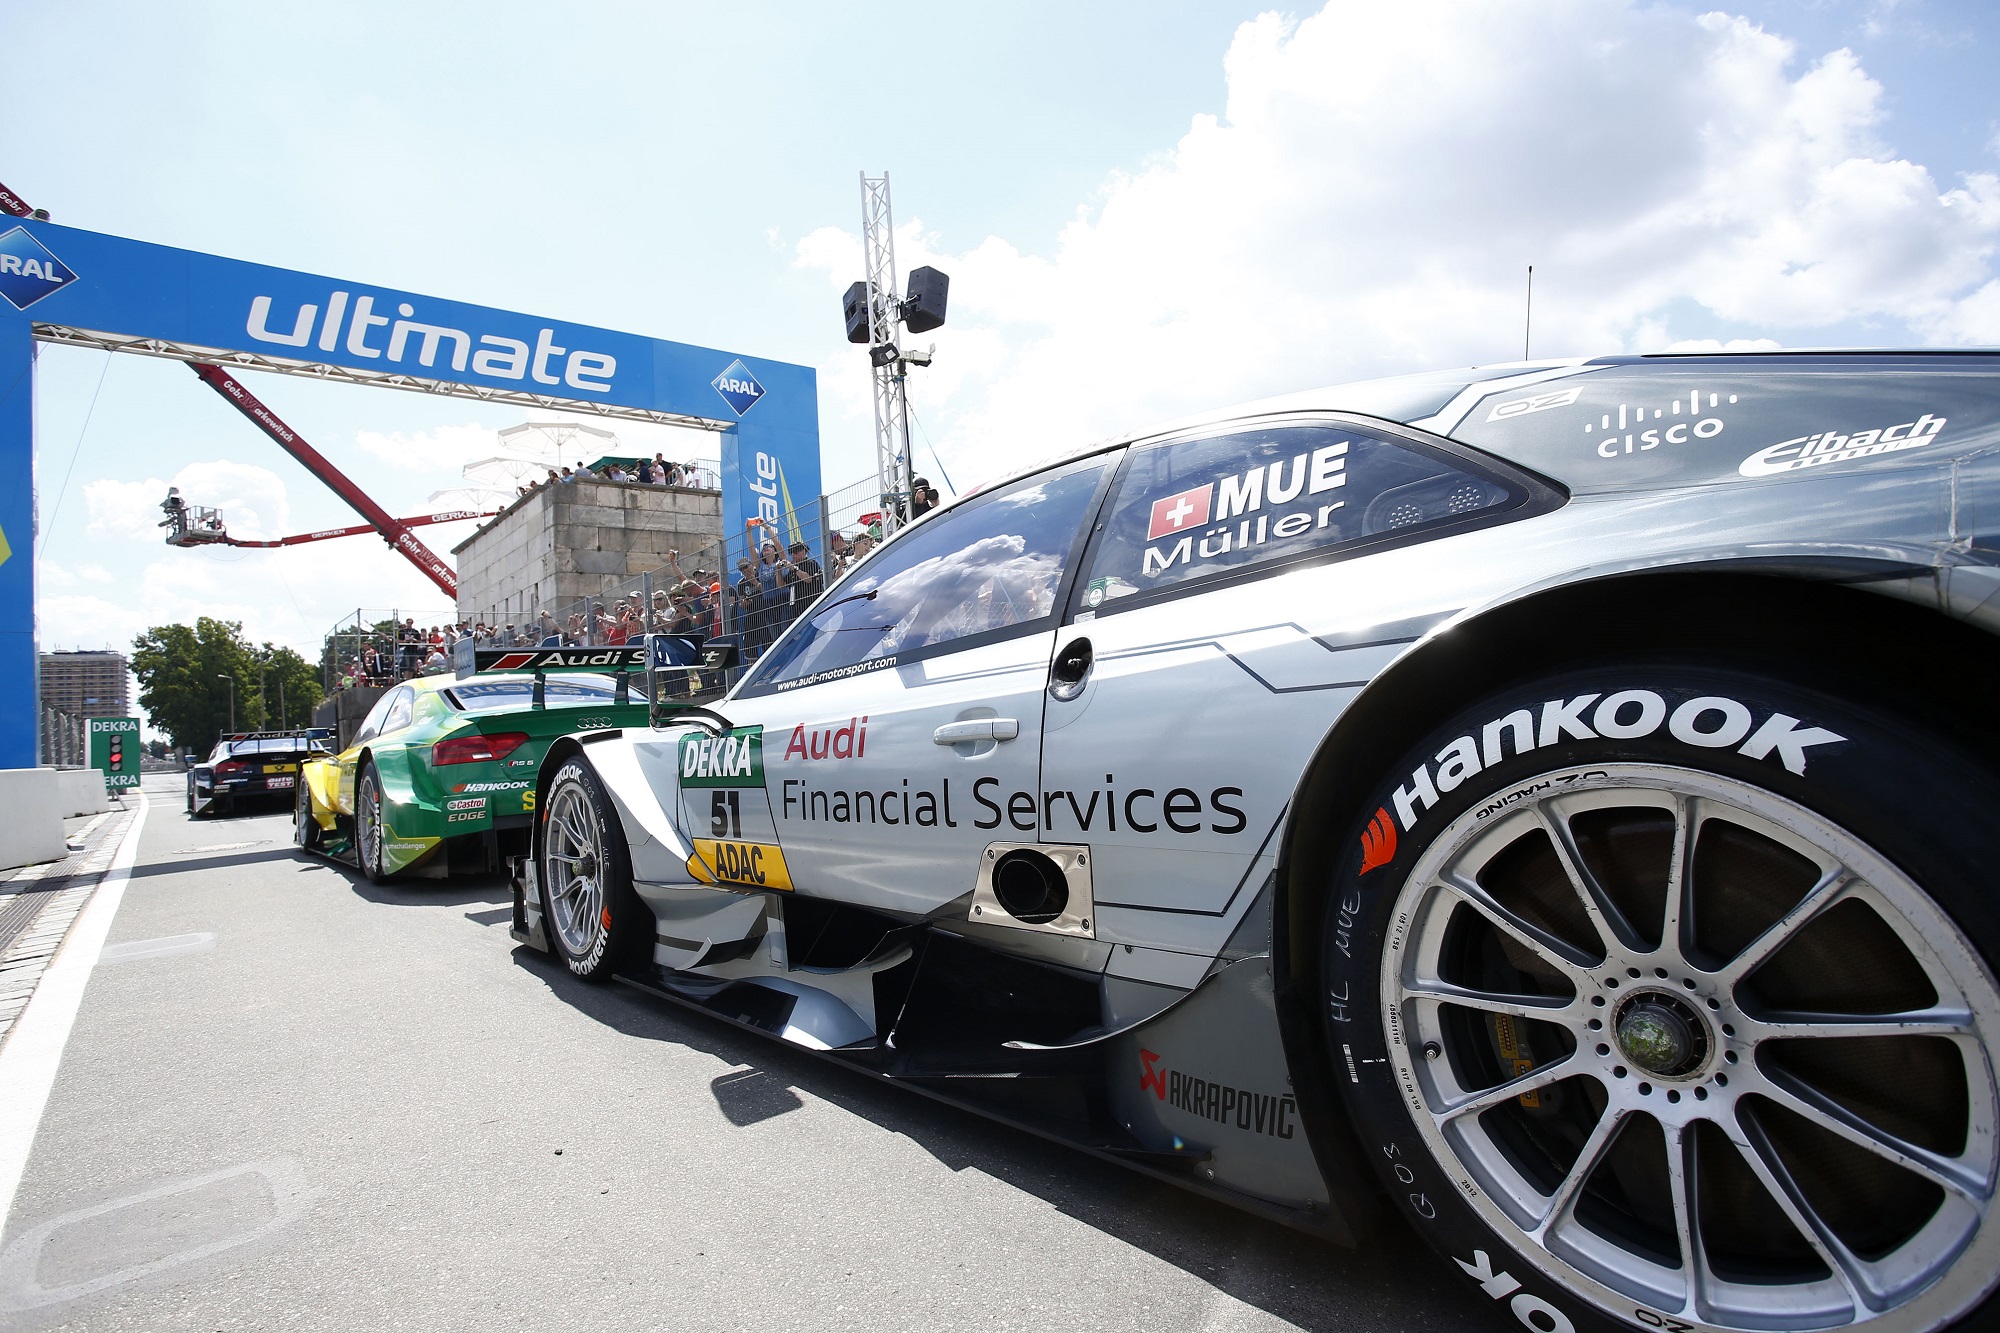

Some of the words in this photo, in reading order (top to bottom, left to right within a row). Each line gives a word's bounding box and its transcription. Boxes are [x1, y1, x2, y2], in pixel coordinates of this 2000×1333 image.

[0, 253, 63, 283] RAL
[246, 291, 617, 392] ultimate
[223, 380, 244, 399] Gebr
[719, 377, 759, 397] ARAL
[1738, 413, 1947, 477] Eibach
[1216, 441, 1350, 522] MUE
[311, 529, 346, 539] GERKEN
[1142, 500, 1345, 576] Müller
[400, 533, 420, 555] Gebr
[417, 546, 457, 590] Markew
[537, 651, 620, 667] Audi
[777, 656, 897, 691] www.audi-motorsport.com
[92, 720, 138, 732] DEKRA
[250, 732, 286, 740] Audi
[783, 715, 869, 761] Audi
[683, 734, 752, 779] DEKRA
[104, 774, 138, 787] EKRA
[447, 810, 487, 823] EDGE
[456, 799, 486, 810] Castrol
[711, 790, 742, 839] 51
[783, 777, 957, 828] Financial
[972, 773, 1248, 835] Services
[716, 842, 766, 885] ADAC
[1460, 1179, 1478, 1198] 2012
